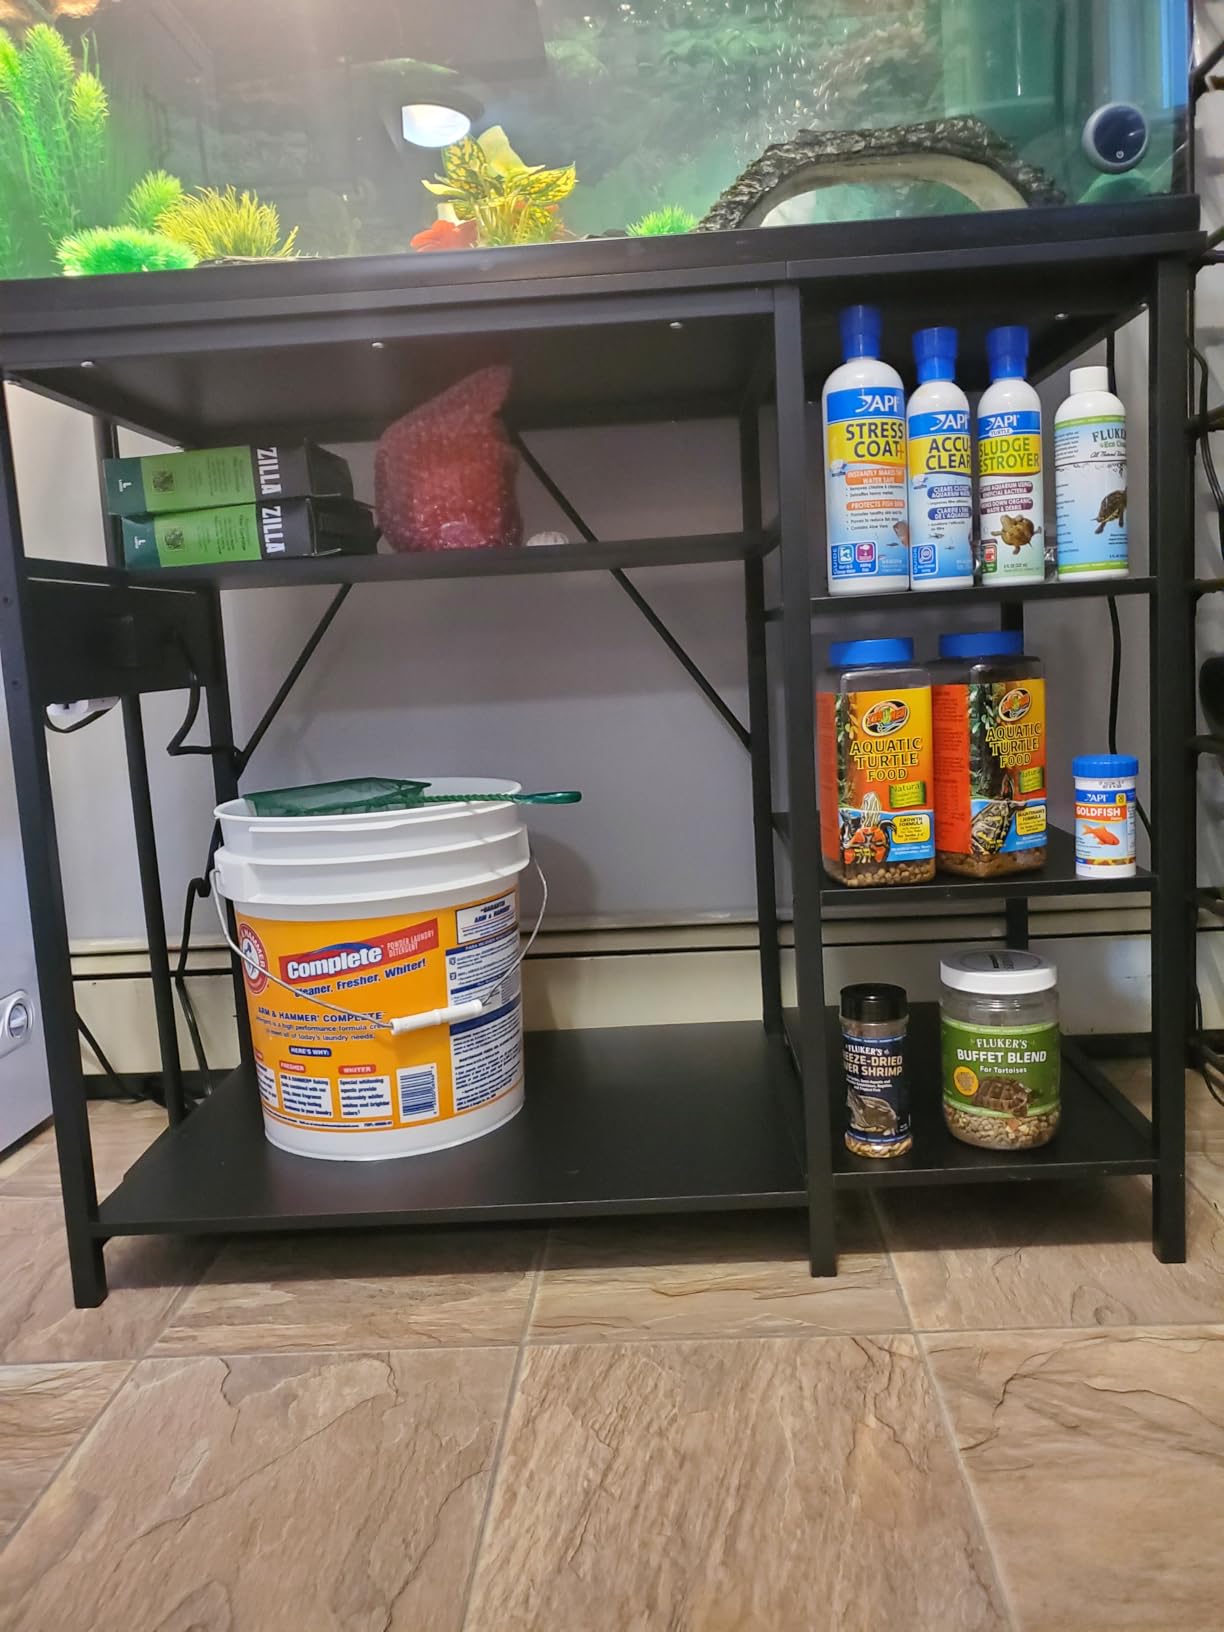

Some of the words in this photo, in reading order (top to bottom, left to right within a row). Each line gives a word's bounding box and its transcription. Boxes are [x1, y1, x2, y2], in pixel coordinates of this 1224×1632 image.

[869, 394, 898, 412] API
[942, 414, 968, 430] API
[993, 414, 1017, 429] API
[846, 421, 904, 441] STRESS
[257, 447, 282, 495] ZILLA
[262, 506, 286, 553] ZILLA
[985, 722, 1041, 742] AQUATIC
[849, 737, 922, 756] AQUATIC
[989, 737, 1040, 756] TURTLE
[854, 752, 919, 770] TURTLE
[1000, 752, 1032, 768] FOOD
[866, 768, 908, 783] FOOD
[1076, 806, 1120, 816] GOLDFISH
[387, 938, 410, 951] POWDER
[286, 946, 383, 980] Complete
[294, 984, 334, 998] Ceaner.
[336, 974, 381, 990] Fresher.
[384, 958, 426, 978] Whiter!
[272, 1009, 276, 1018] &
[323, 1012, 382, 1022] COMPLTE
[976, 1038, 1028, 1049] FLUKER'S
[957, 1048, 1004, 1063] BUFFET
[1008, 1050, 1046, 1064] BLEND
[861, 1066, 902, 1077] SHRIMP
